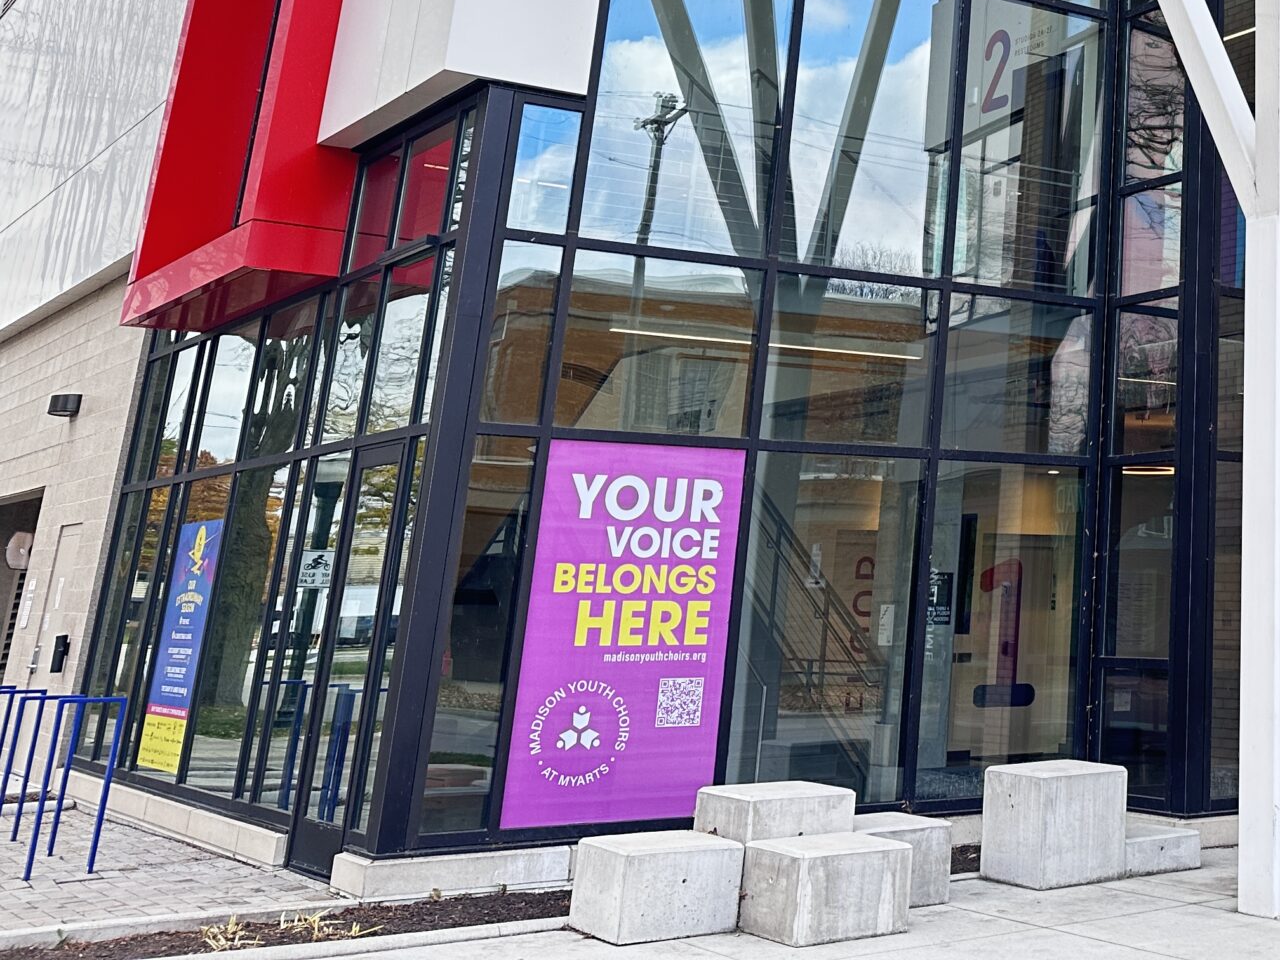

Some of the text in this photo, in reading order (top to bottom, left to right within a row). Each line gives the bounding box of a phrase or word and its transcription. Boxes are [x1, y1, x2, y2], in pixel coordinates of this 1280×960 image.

[981, 29, 1011, 114] 2
[572, 473, 723, 523] YOUR
[606, 527, 719, 560] VOICE
[552, 563, 716, 595] BELONGS
[574, 600, 711, 647] HERE
[972, 559, 1035, 707] 1
[603, 651, 706, 664] madisonyouthchoirs.org
[529, 680, 630, 755] MADISON YOUTH CHOIRS
[540, 763, 609, 787] AT MYARTS
